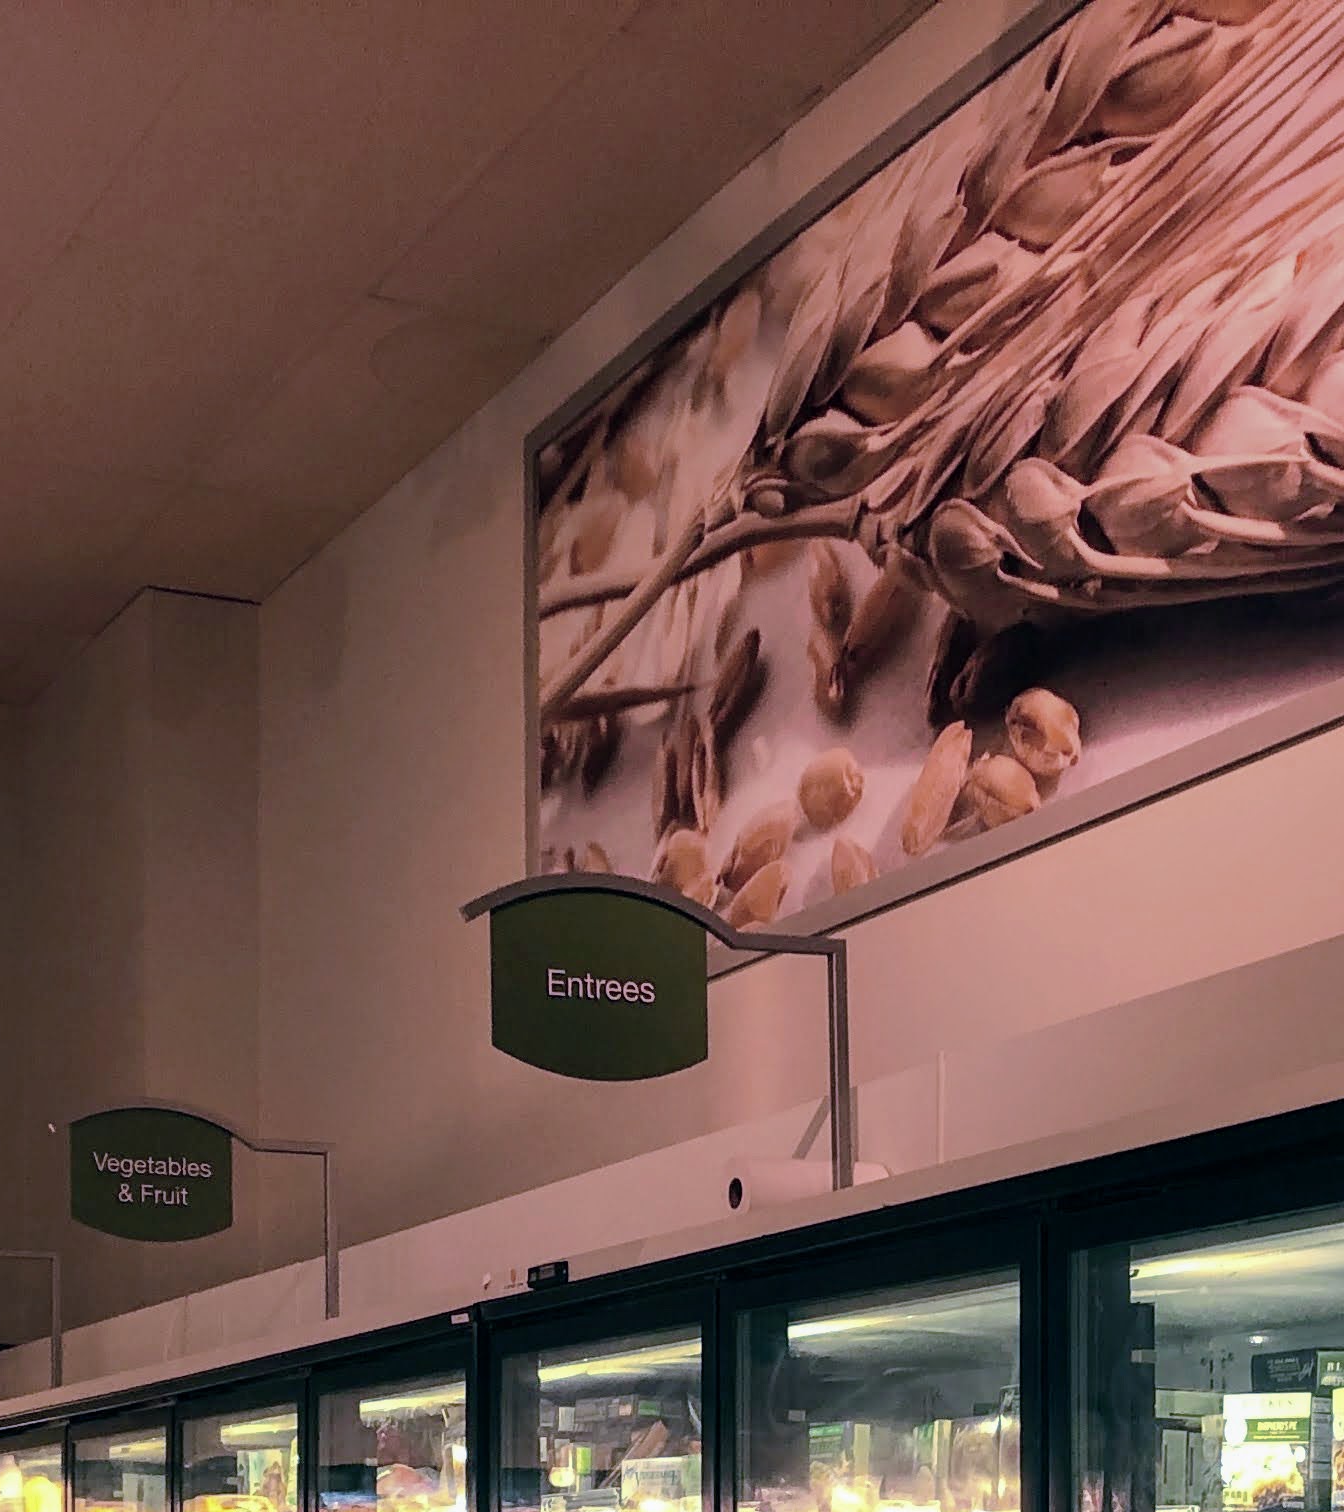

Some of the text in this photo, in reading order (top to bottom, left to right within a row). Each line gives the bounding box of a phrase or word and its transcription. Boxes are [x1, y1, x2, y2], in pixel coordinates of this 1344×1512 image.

[547, 967, 656, 1003] Entrees
[92, 1151, 212, 1178] Vegetables
[118, 1183, 188, 1206] & Fruit
